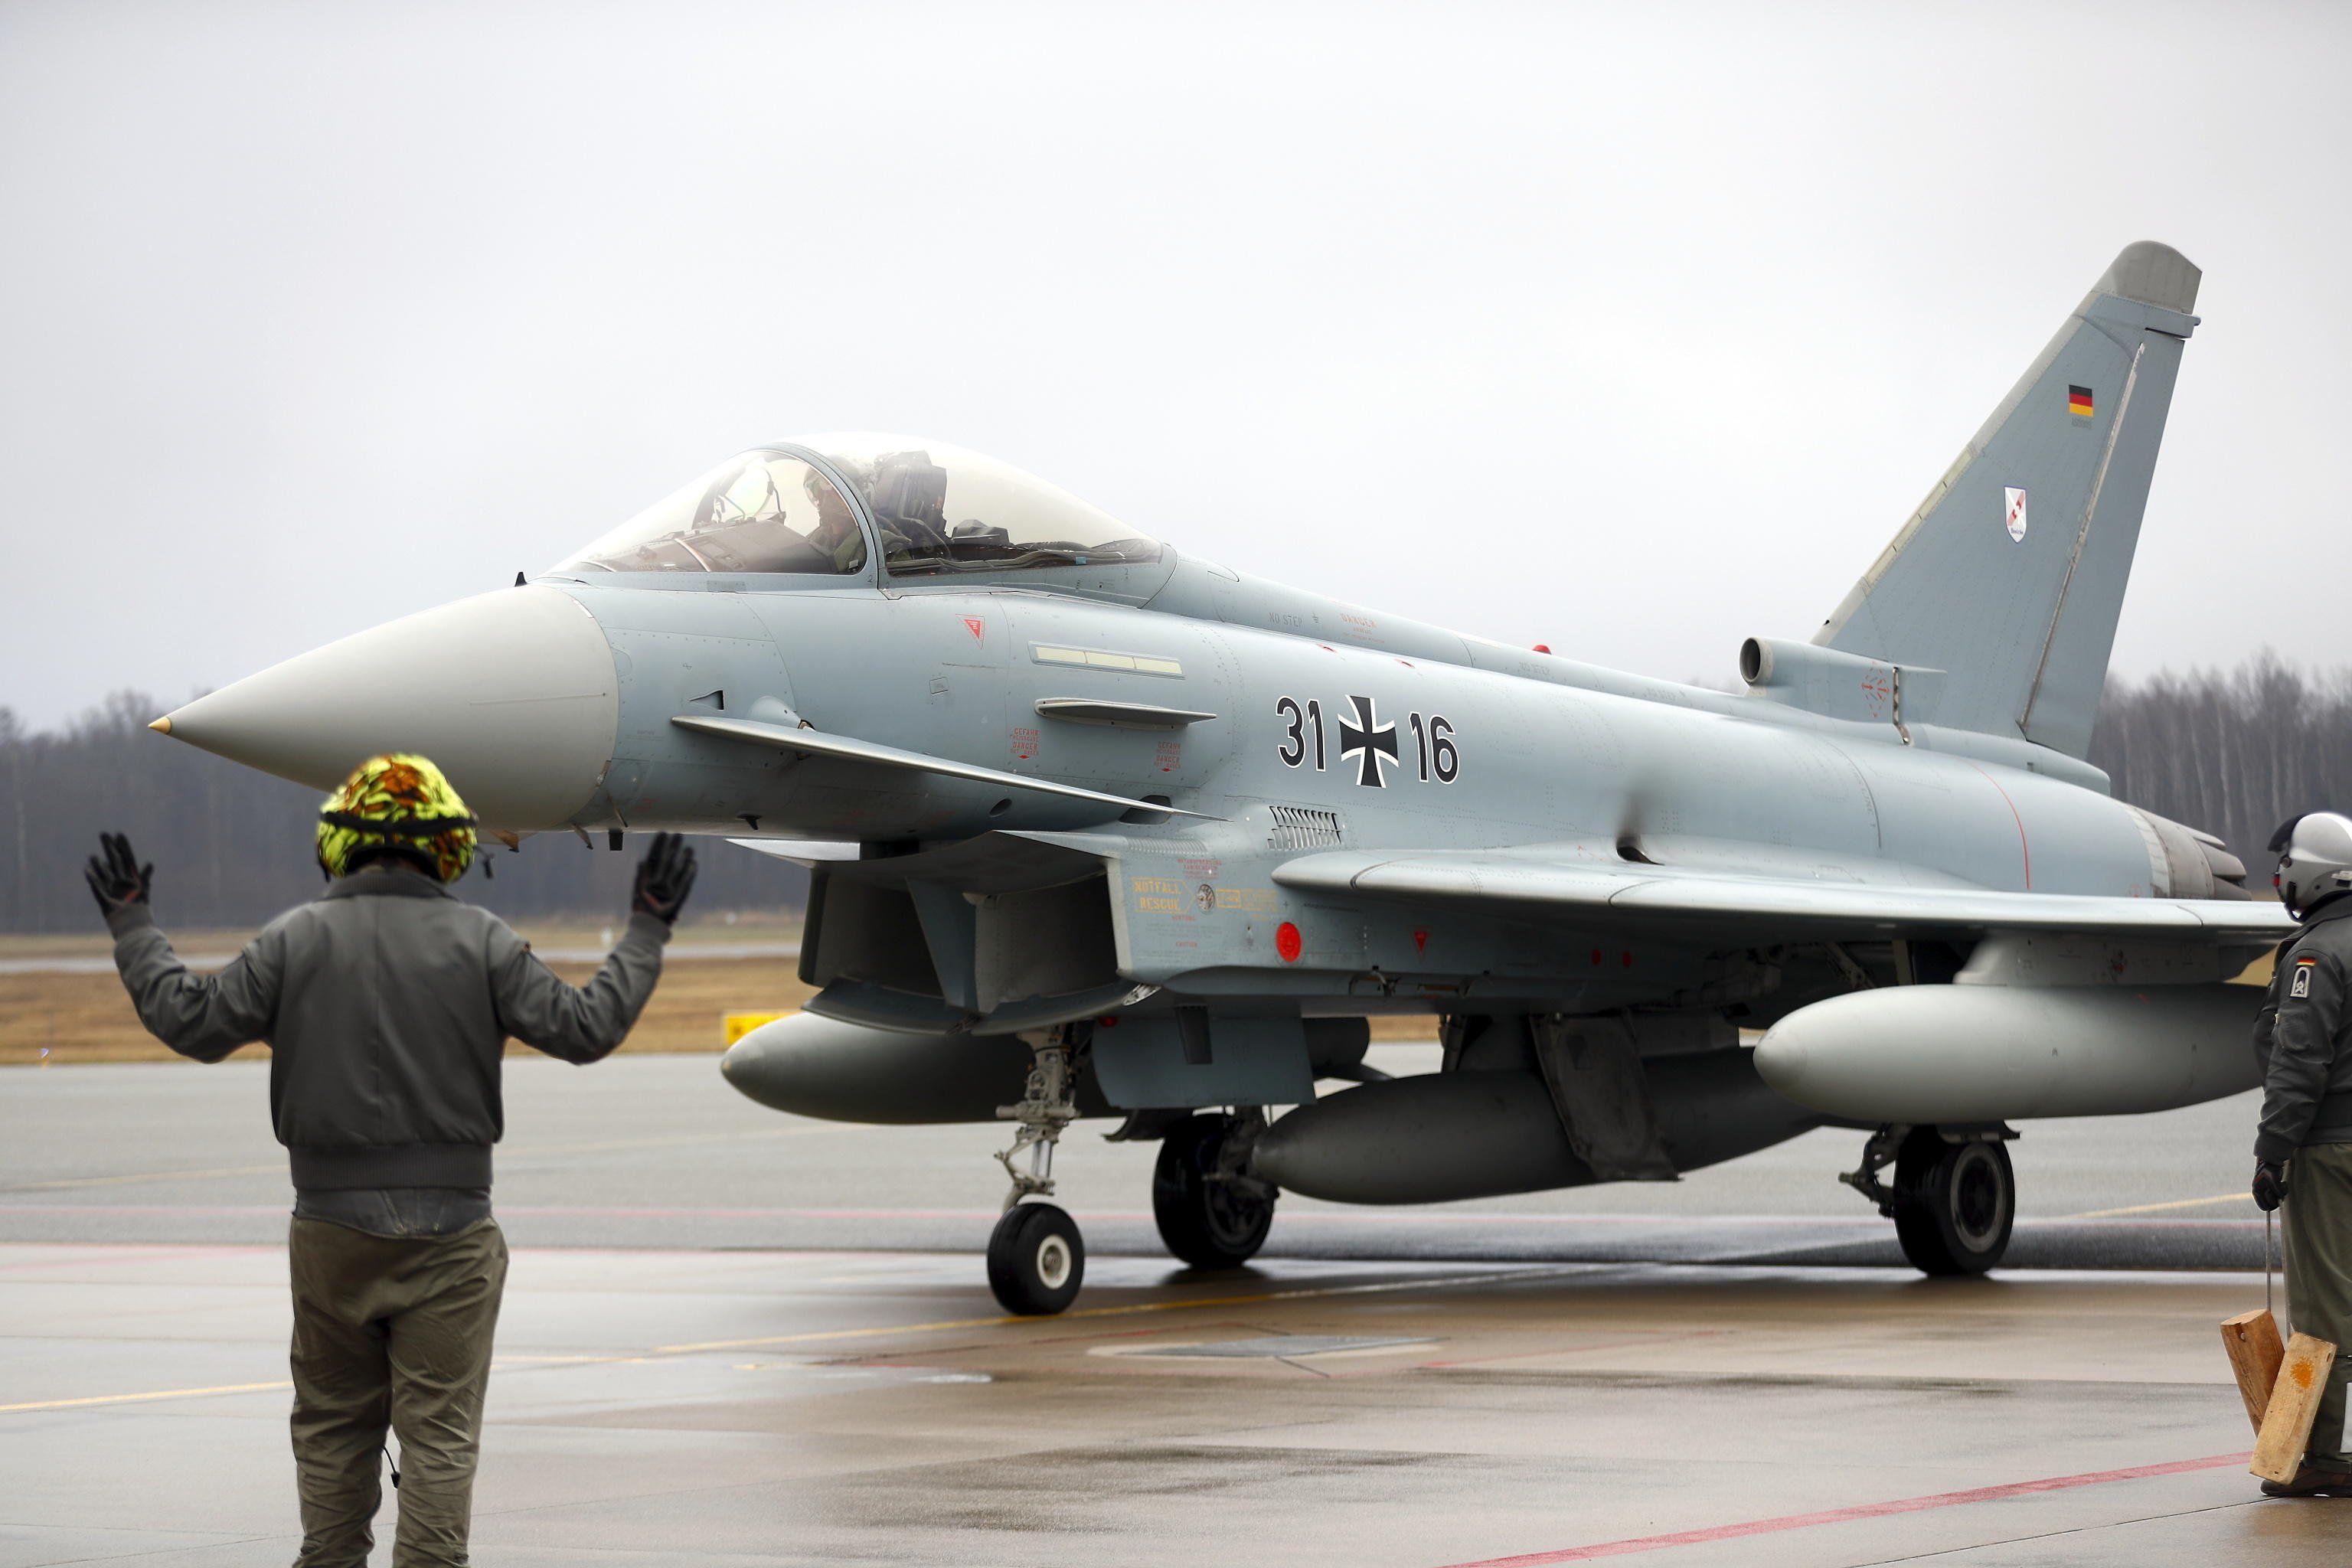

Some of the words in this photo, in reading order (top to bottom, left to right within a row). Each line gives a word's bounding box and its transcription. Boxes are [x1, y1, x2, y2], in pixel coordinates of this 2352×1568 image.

[1269, 612, 1280, 624] NO
[1283, 615, 1302, 628] STEP
[1013, 742, 1038, 750] DANGER
[1276, 695, 1326, 773] 31
[1409, 710, 1460, 785] 16
[1133, 881, 1182, 895] NOTFALL
[1139, 897, 1181, 910] RESCUE
